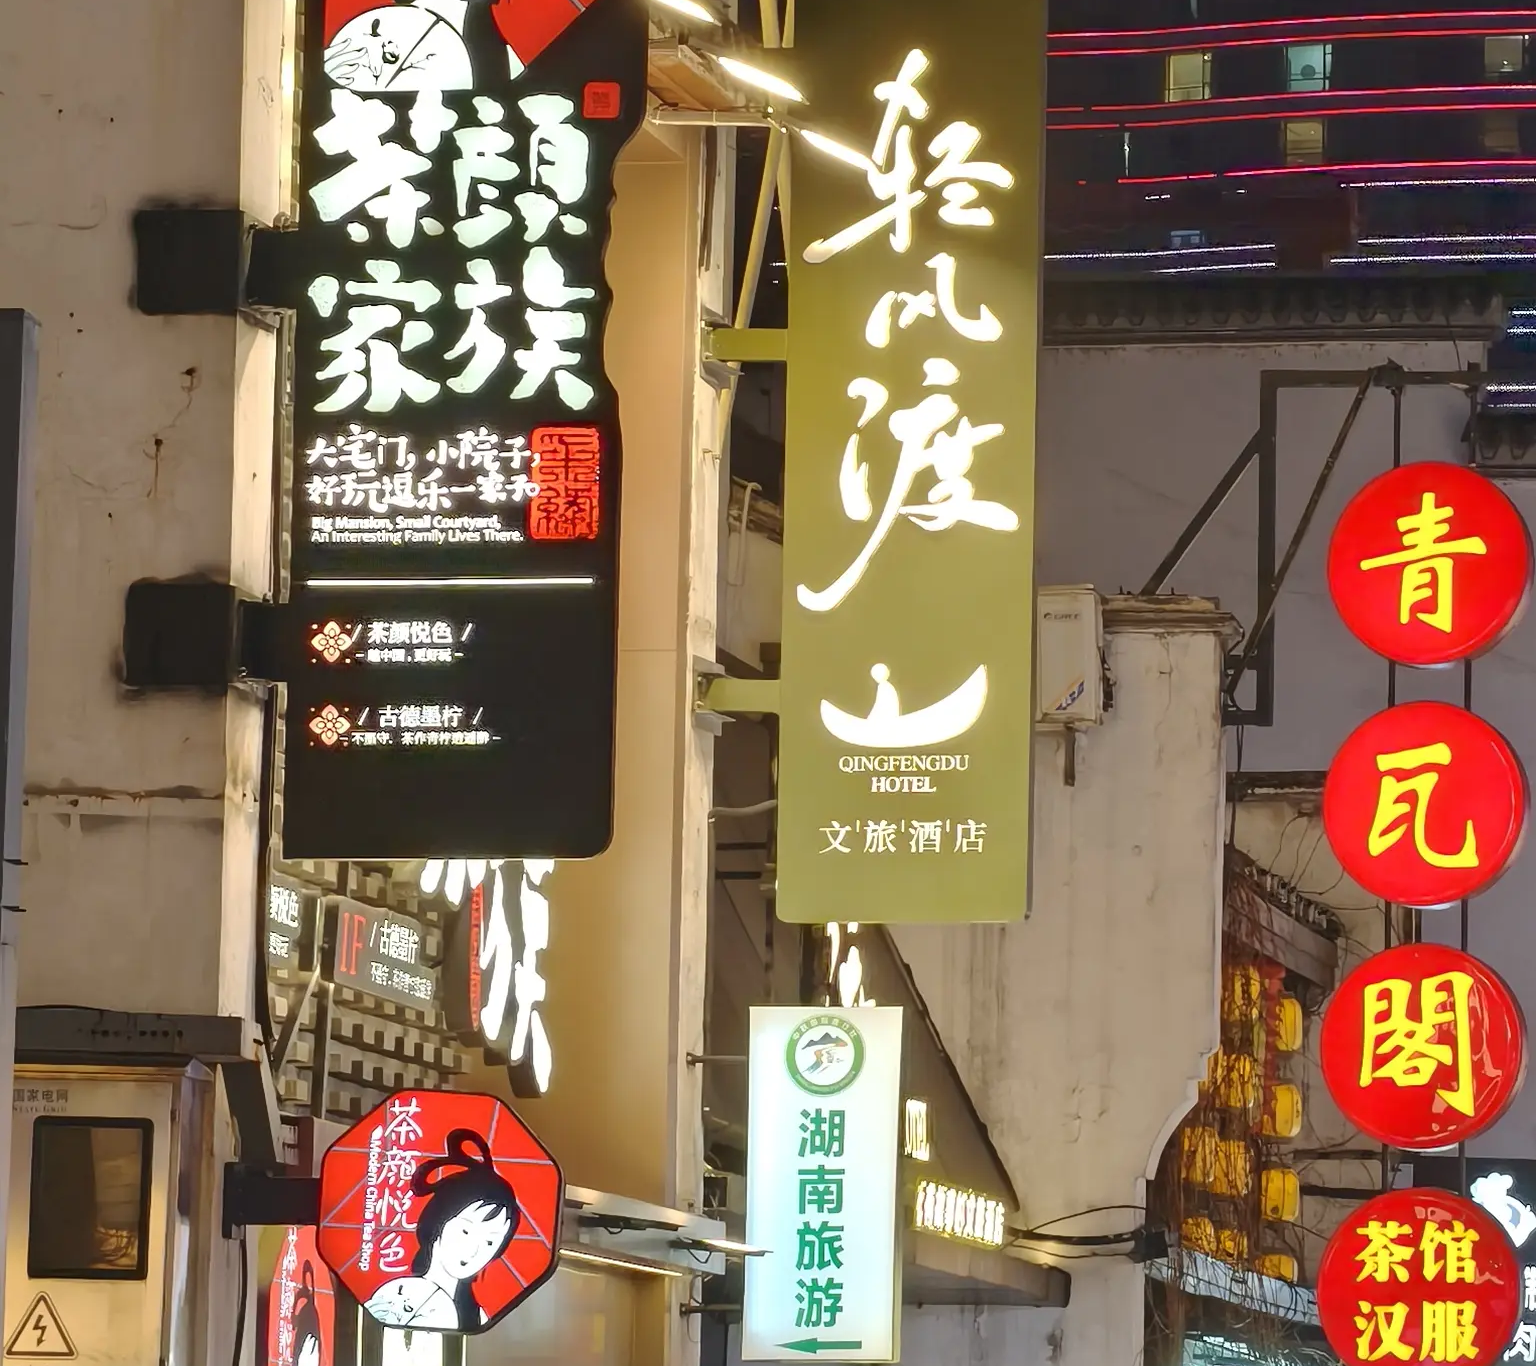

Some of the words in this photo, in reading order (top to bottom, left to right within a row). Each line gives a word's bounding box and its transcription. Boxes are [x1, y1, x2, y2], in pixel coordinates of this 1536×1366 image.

[306, 246, 595, 412] 家族
[797, 48, 1019, 612] 轻风渡
[311, 530, 329, 543] An
[332, 529, 402, 546] Interesting
[405, 530, 446, 545] Family
[448, 530, 481, 542] Lives
[484, 529, 524, 542] There.
[336, 515, 394, 531] Mansion,
[396, 515, 431, 528] Small
[433, 515, 501, 531] Courtyard,
[367, 621, 453, 645] 茶颜悦色
[838, 755, 970, 773] QINGFENGDU
[870, 776, 937, 793] HOTEL
[364, 1186, 378, 1220] China
[795, 1108, 846, 1329] 湖南旅游
[358, 1241, 374, 1273] Shop
[1354, 1219, 1481, 1285] 茶馆
[1353, 1299, 1480, 1363] 汉服
